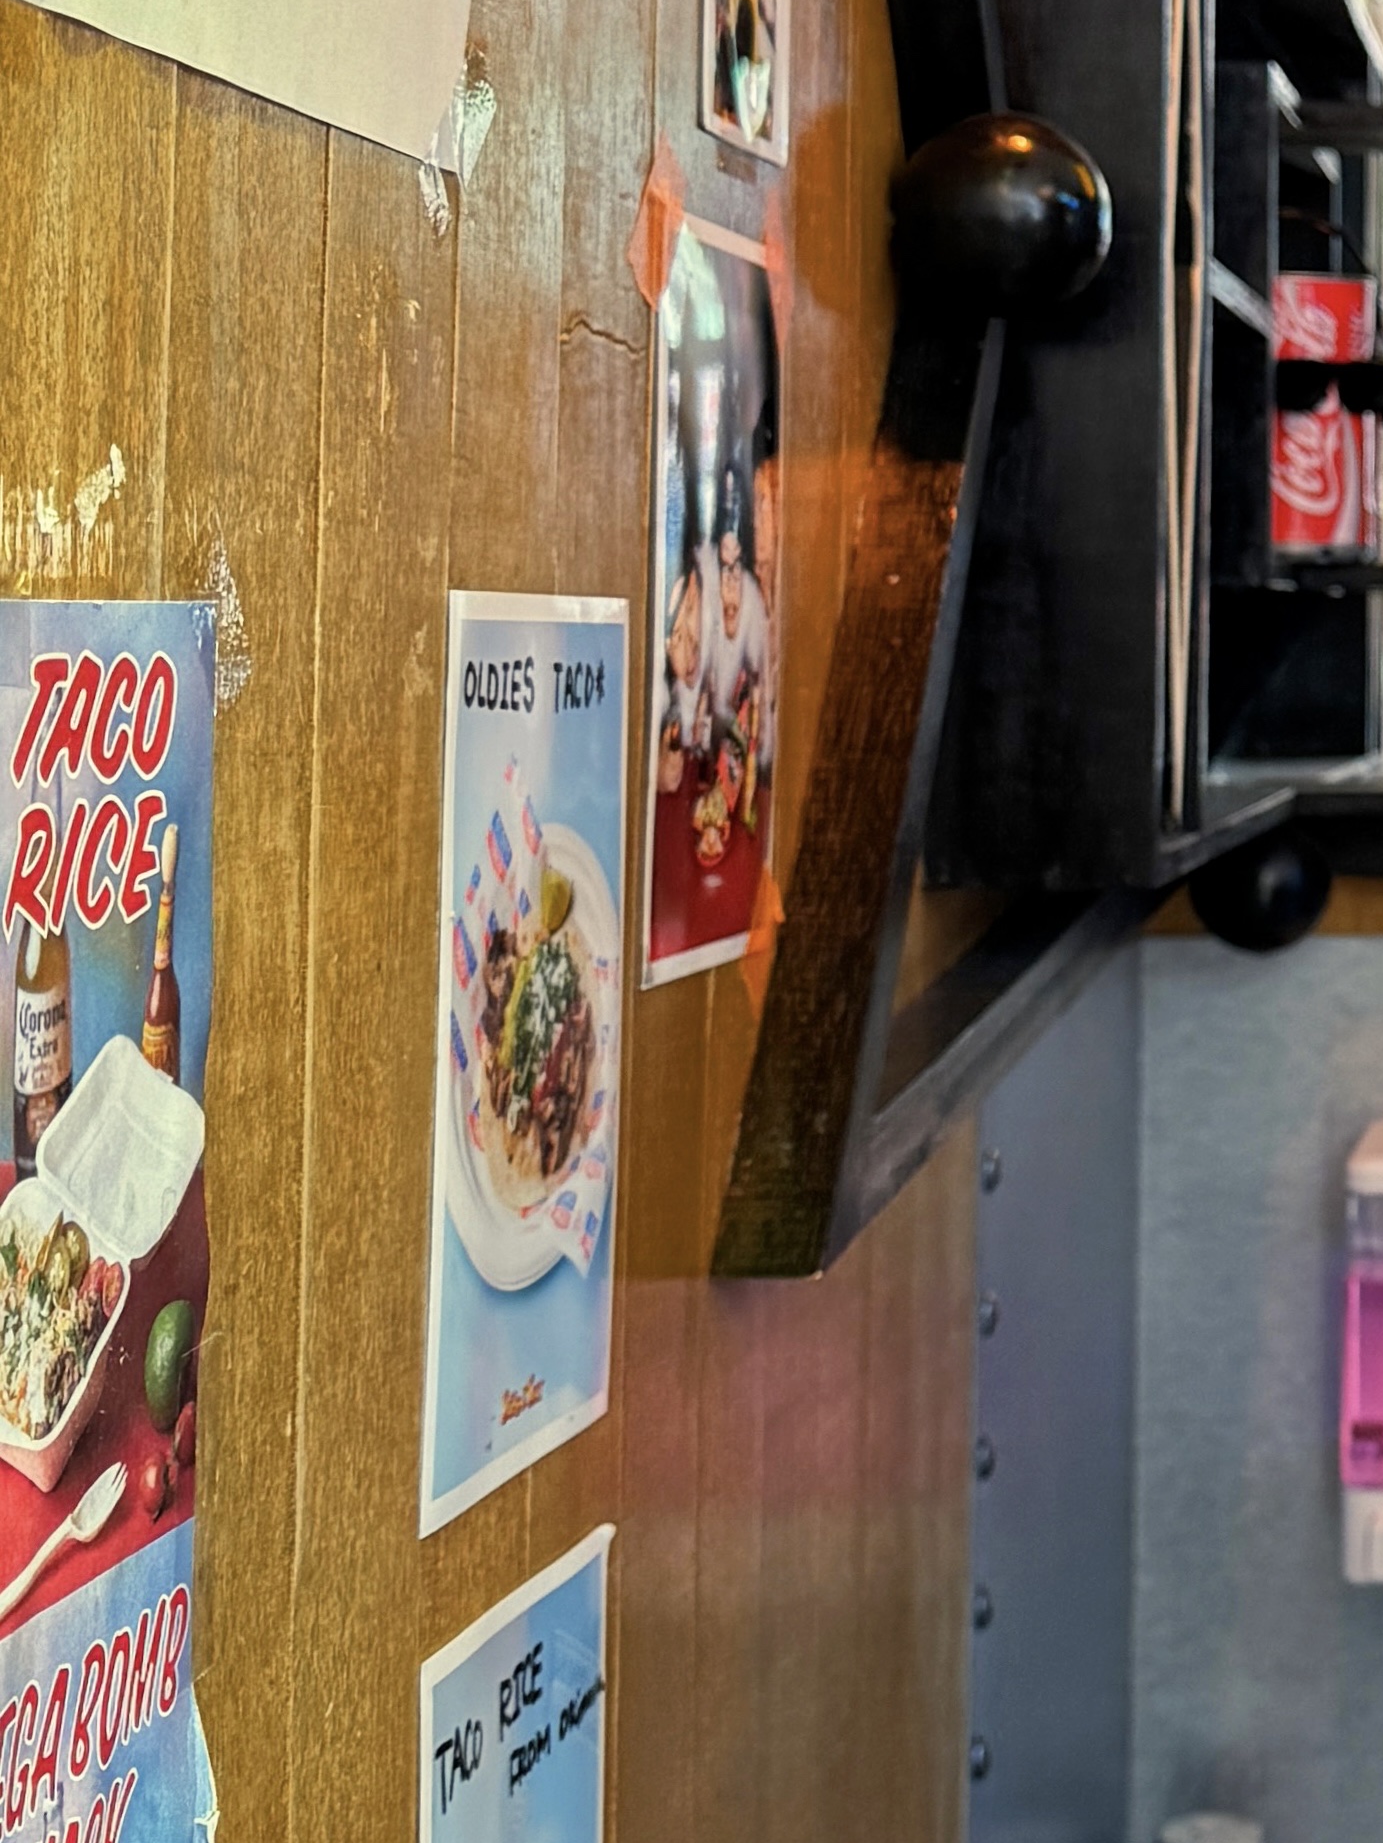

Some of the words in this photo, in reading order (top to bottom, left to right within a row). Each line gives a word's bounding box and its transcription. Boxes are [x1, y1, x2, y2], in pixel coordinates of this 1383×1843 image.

[11, 650, 177, 787] TACO
[464, 655, 536, 714] OLDIES
[3, 790, 167, 944] RICE
[70, 1582, 190, 1782] BOMB
[435, 1718, 484, 1816] TACO
[499, 1640, 544, 1744] RICE
